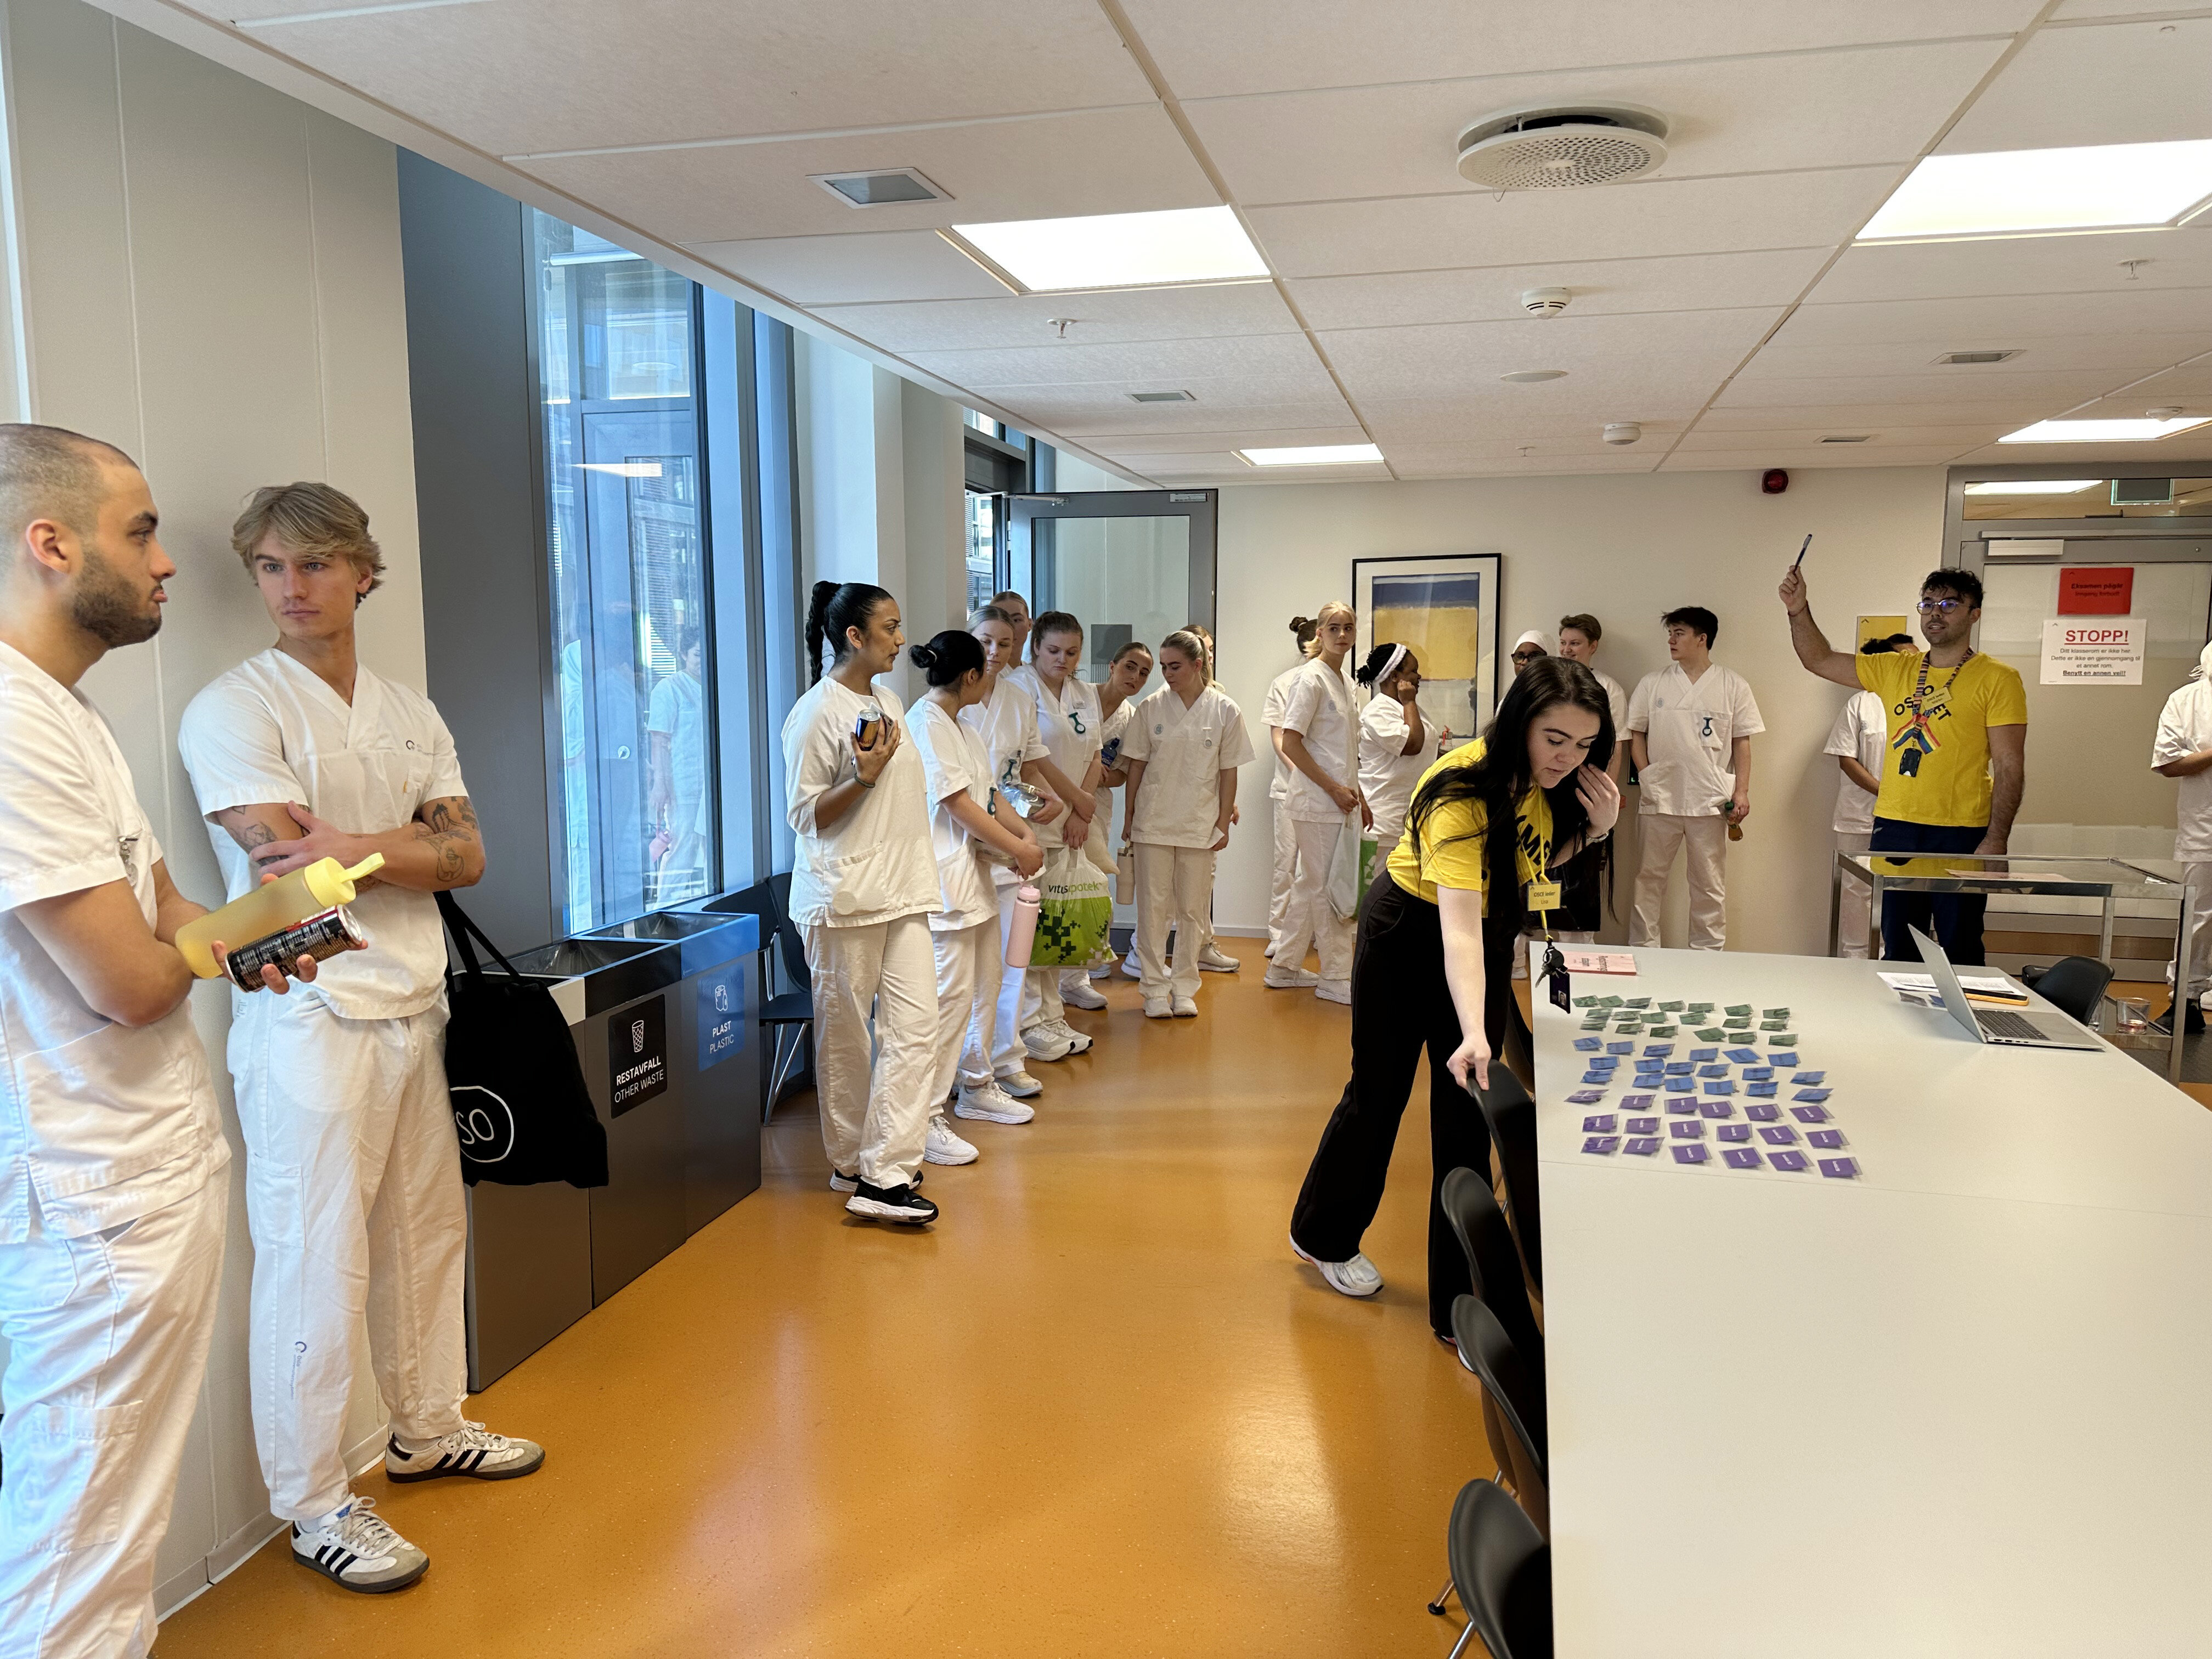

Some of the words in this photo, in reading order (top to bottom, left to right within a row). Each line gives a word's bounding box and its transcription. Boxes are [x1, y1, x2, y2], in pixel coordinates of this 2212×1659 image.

[2065, 630, 2129, 642] STOPP!
[712, 1020, 731, 1038] PLAST
[709, 1034, 734, 1054] PLASTIC
[616, 1056, 661, 1086] RESTAVFALL
[614, 1082, 639, 1103] OTHER
[640, 1069, 664, 1090] WASTE
